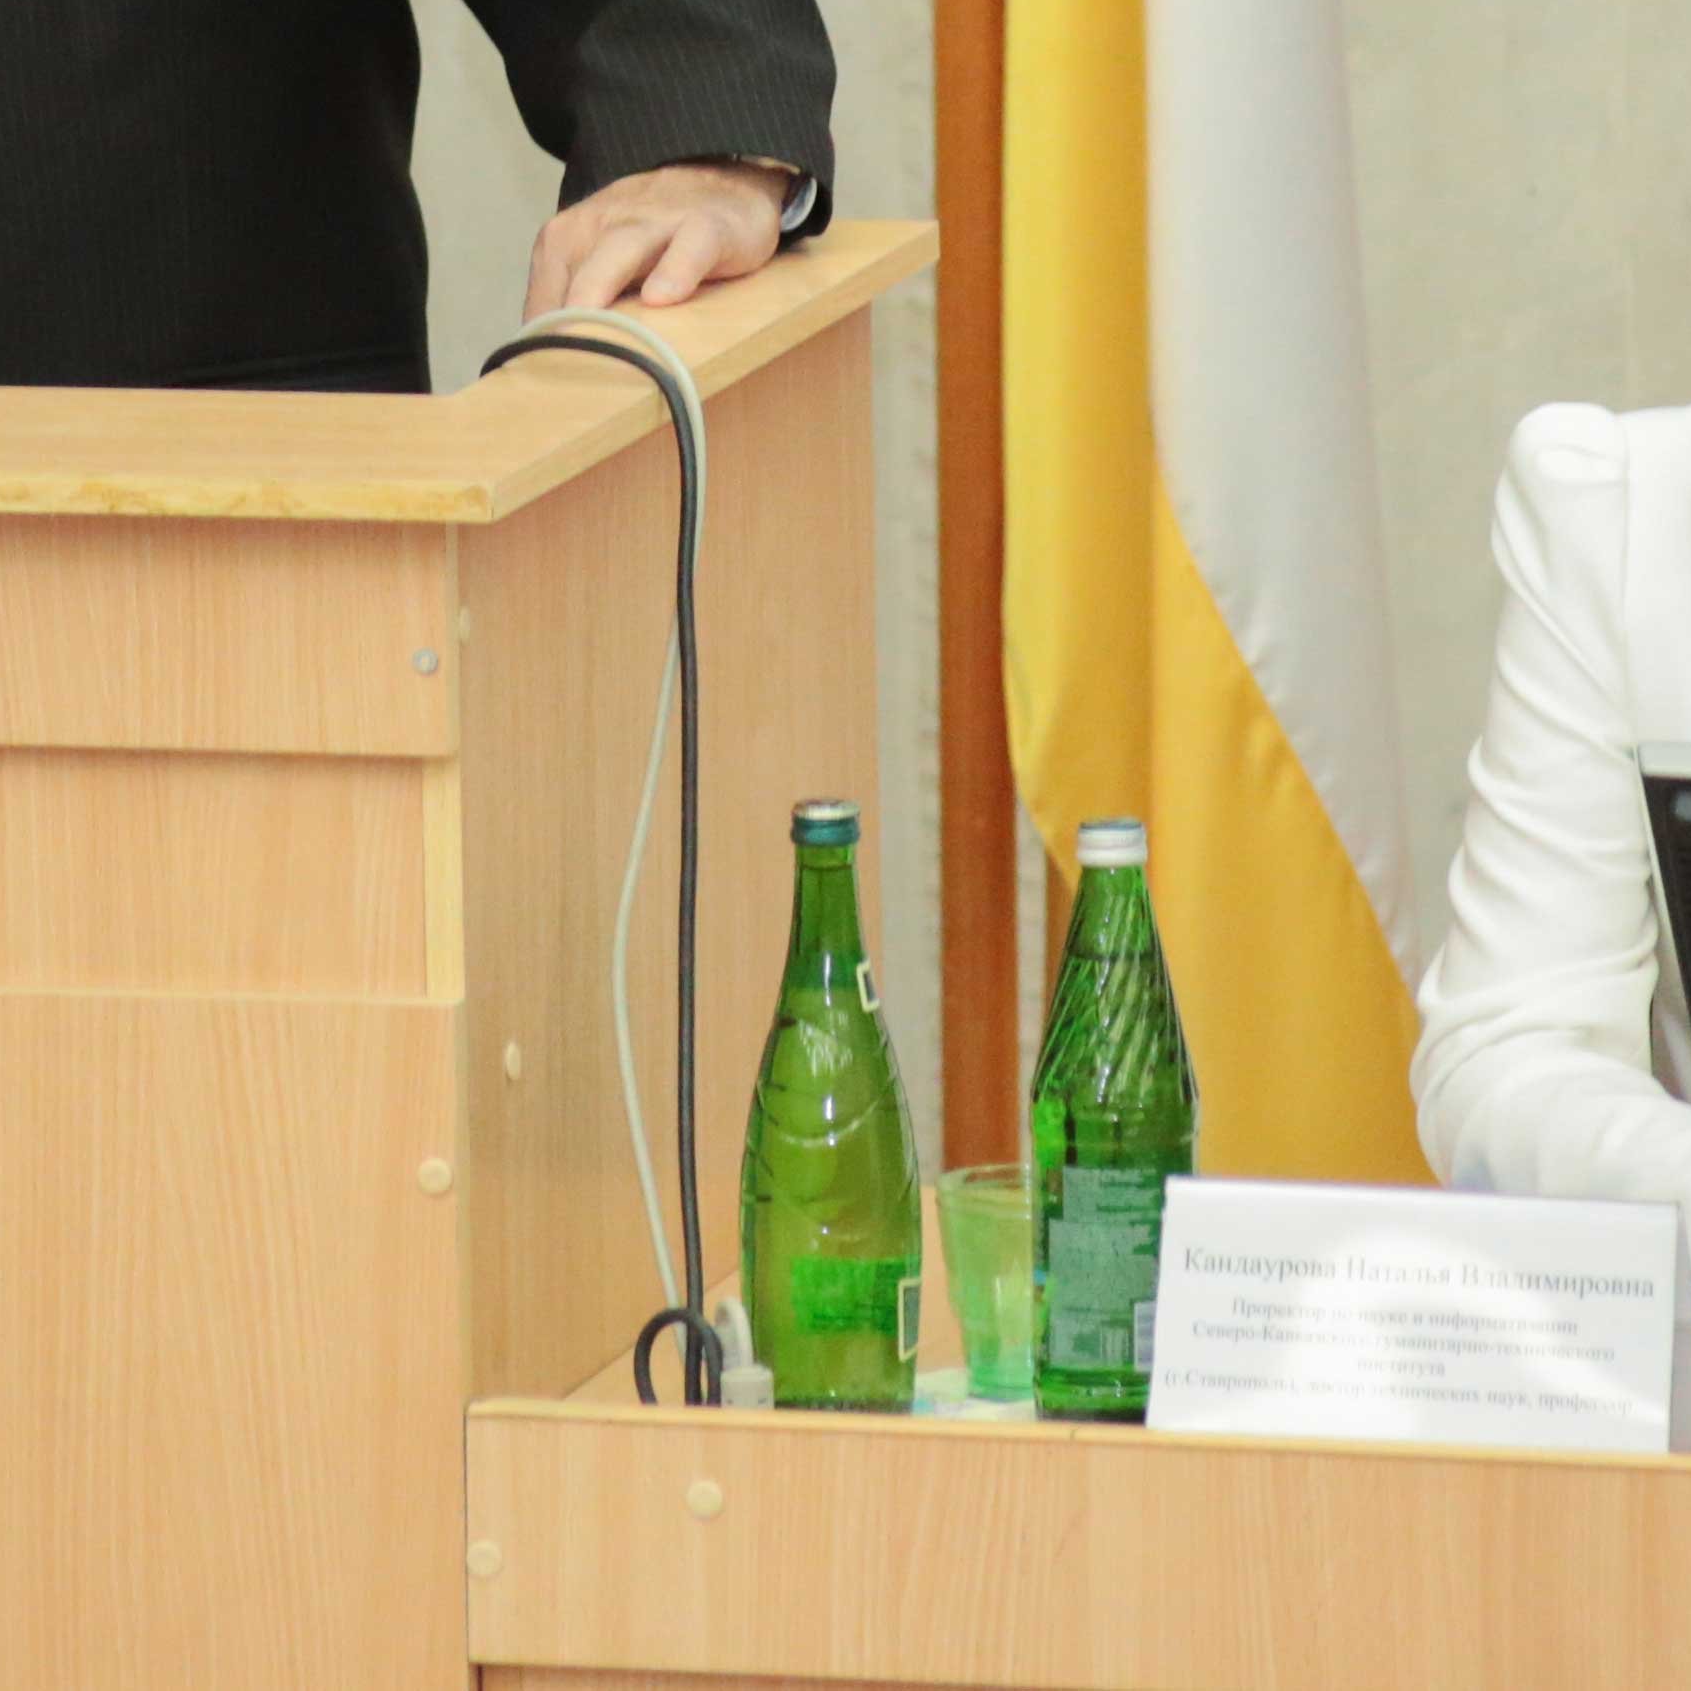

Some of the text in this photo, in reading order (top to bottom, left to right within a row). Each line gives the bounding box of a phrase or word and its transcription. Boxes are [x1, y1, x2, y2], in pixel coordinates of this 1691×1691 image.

[1184, 1247, 1654, 1299] Кандаурова Наталья Владимировна
